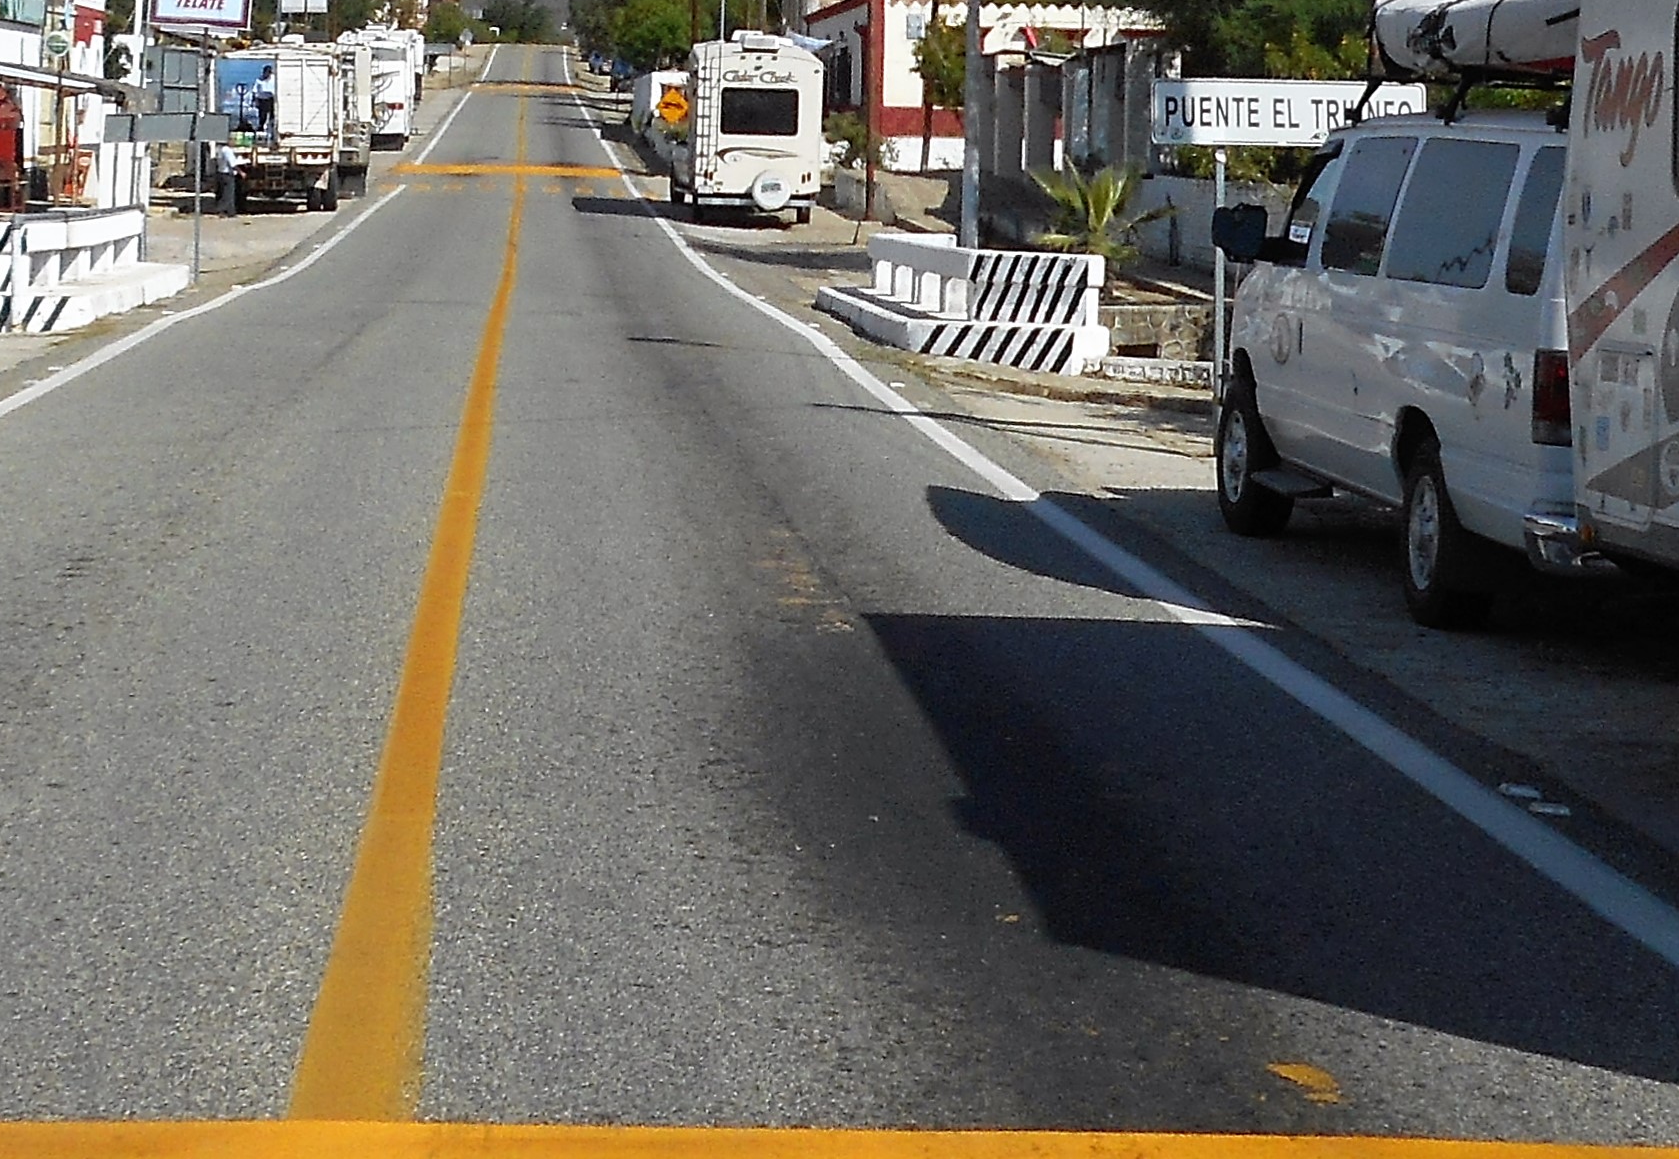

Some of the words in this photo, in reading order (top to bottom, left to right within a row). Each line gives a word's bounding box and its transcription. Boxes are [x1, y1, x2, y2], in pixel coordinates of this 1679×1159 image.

[1165, 96, 1260, 128] PUENTE
[1272, 97, 1301, 129] EL
[1582, 29, 1665, 167] Tango
